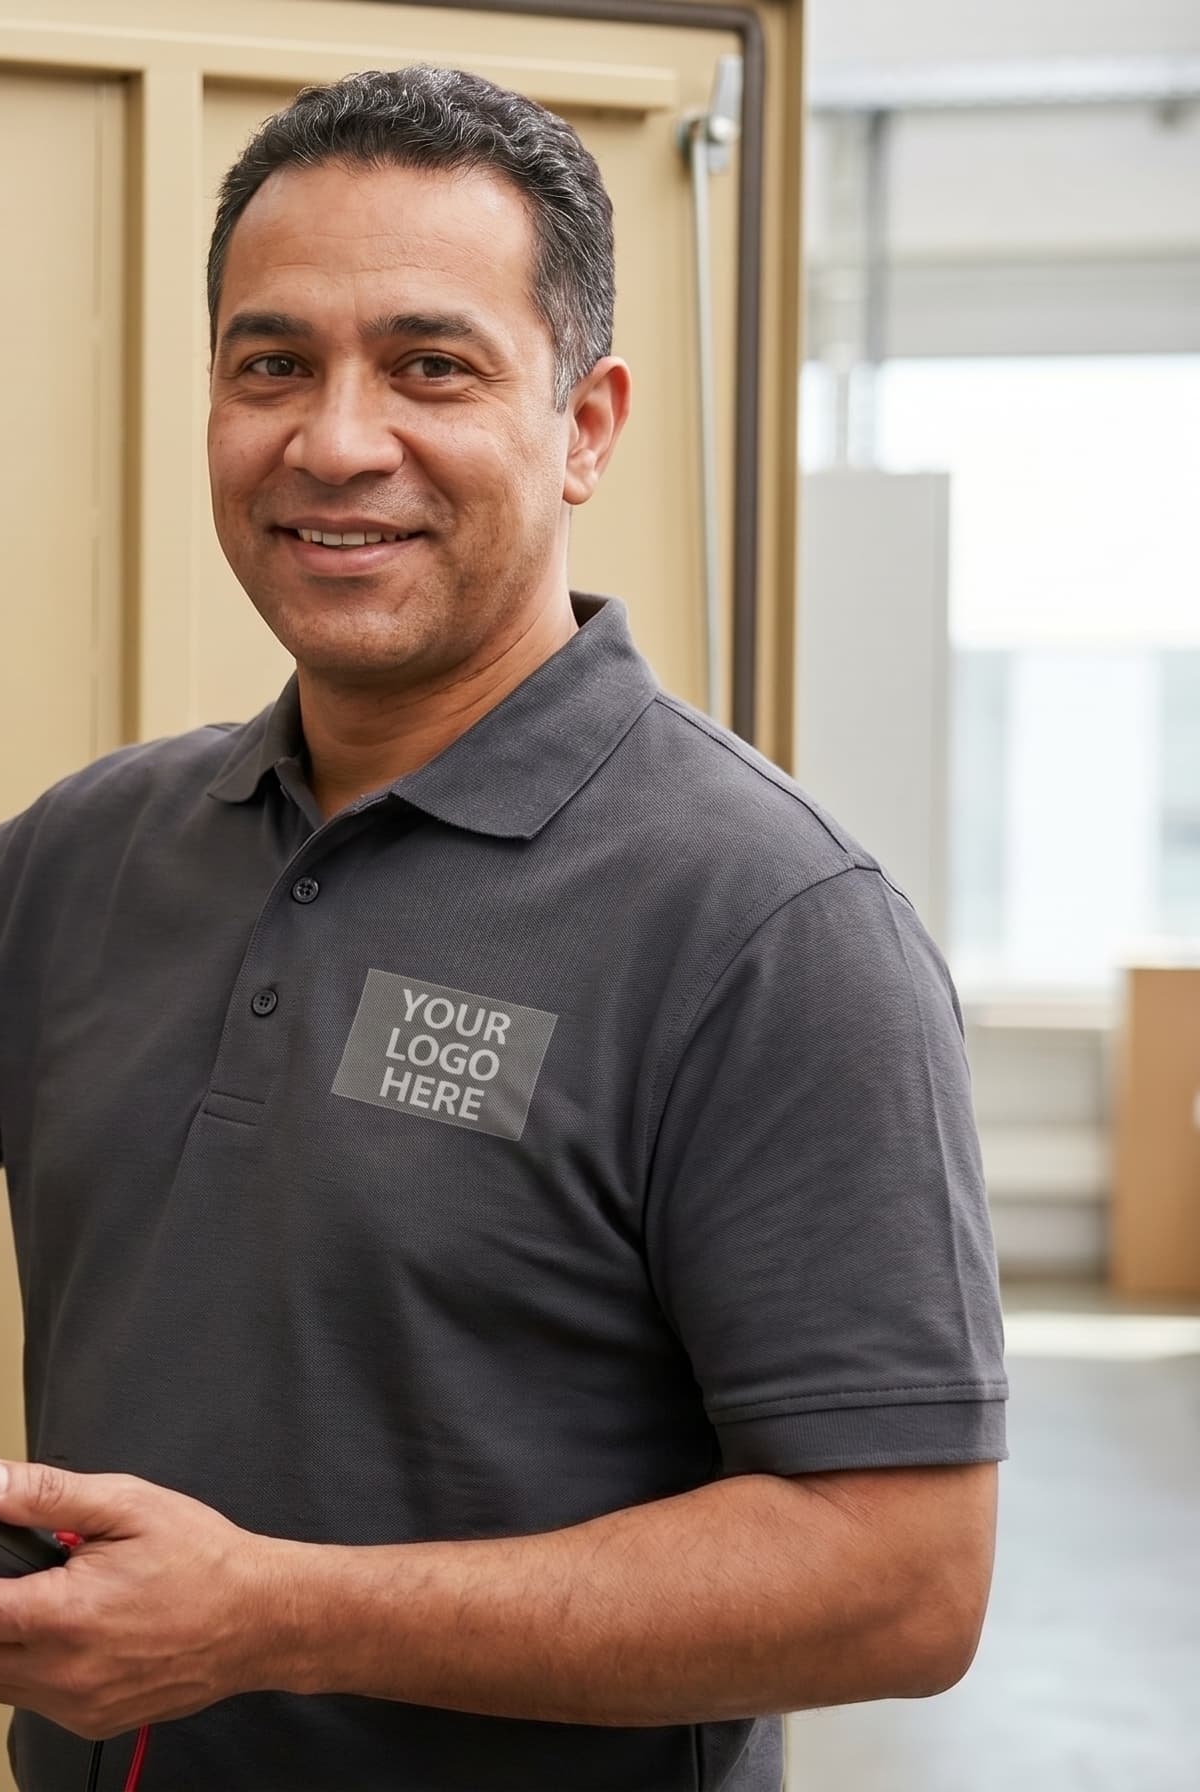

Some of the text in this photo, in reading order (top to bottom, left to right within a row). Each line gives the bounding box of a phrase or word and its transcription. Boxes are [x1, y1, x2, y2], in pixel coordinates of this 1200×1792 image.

[403, 989, 511, 1045] YOUR
[385, 1027, 500, 1081] LOGO
[379, 1066, 484, 1121] HERE
